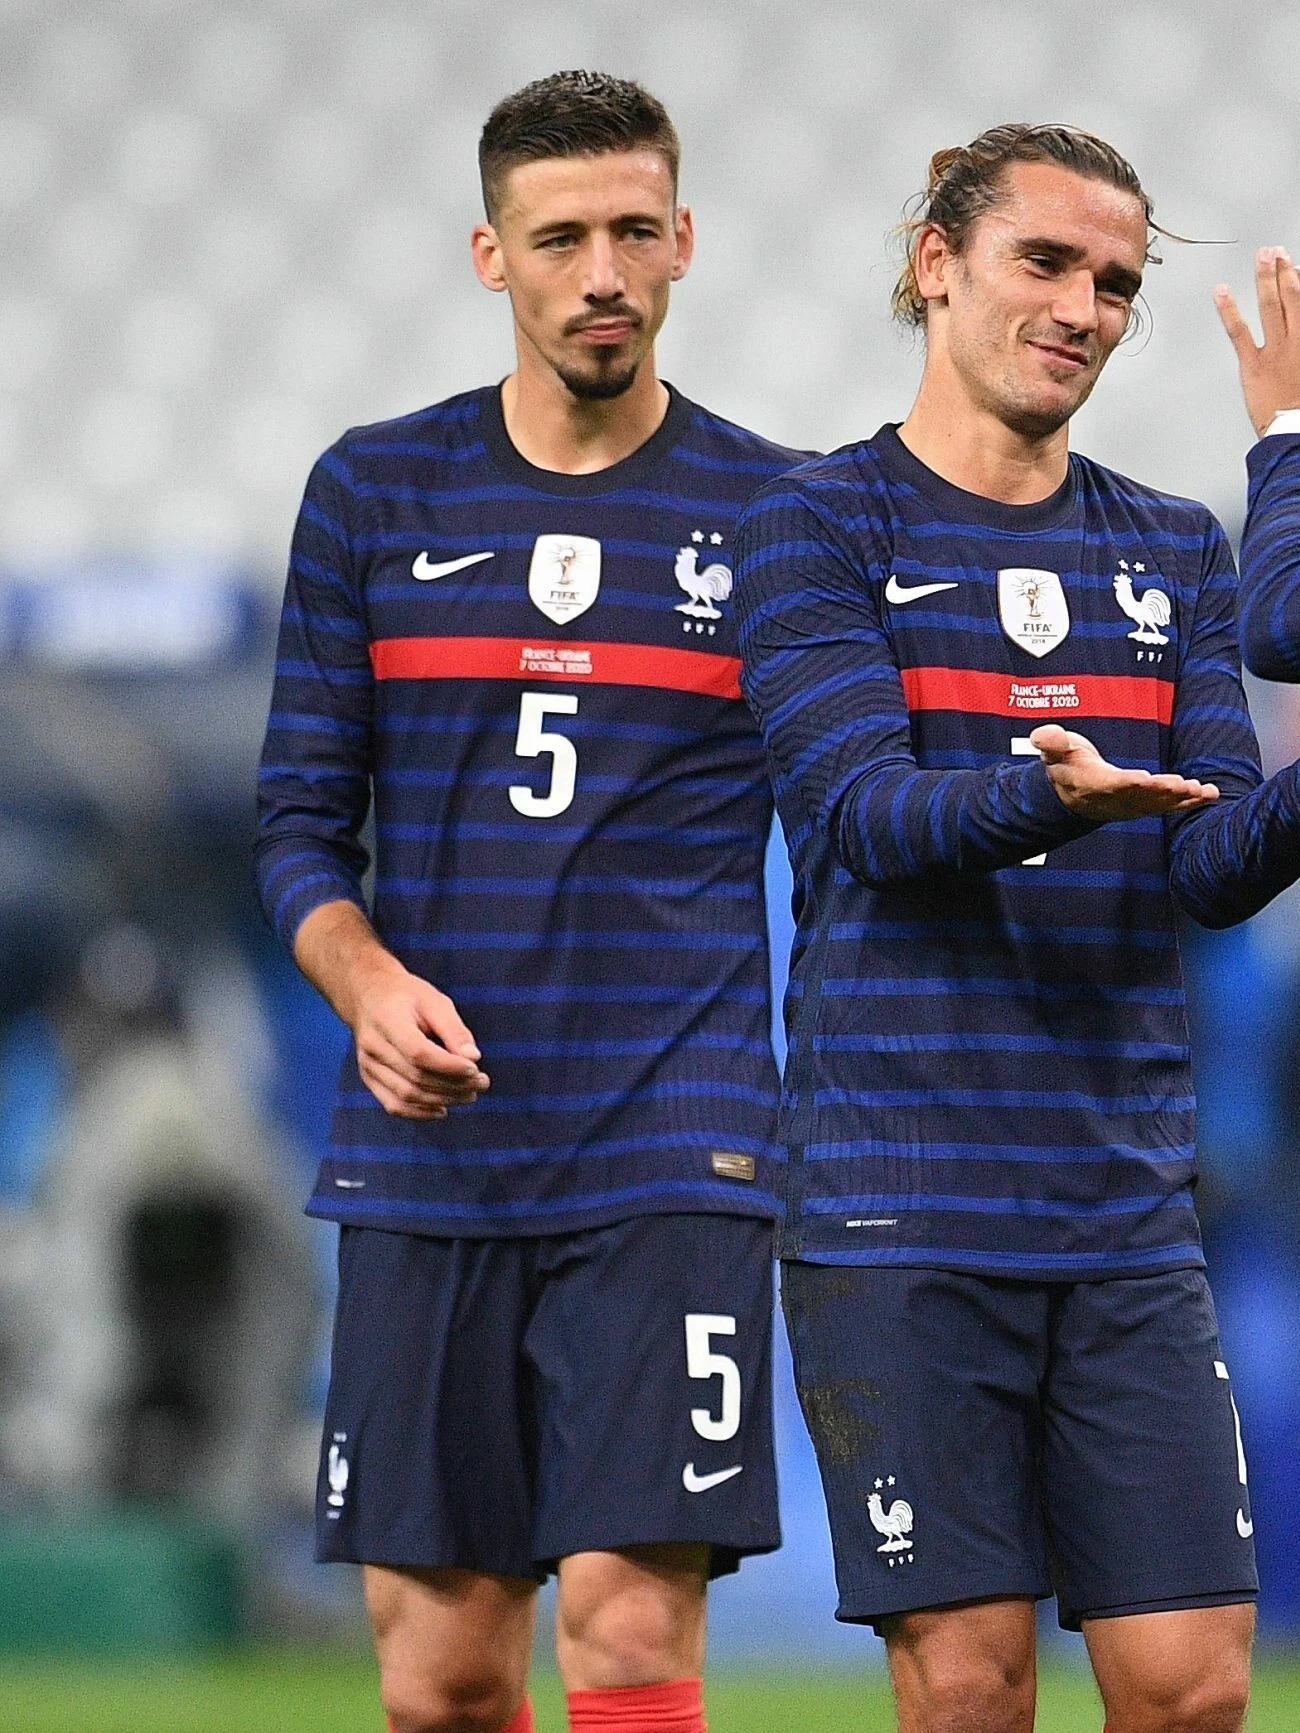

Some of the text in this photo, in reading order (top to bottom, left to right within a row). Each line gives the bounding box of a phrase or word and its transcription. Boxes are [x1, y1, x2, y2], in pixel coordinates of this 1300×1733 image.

[1023, 622, 1051, 633] FIFA
[1010, 683, 1077, 697] FRANCE-UKRAINE
[1007, 695, 1080, 709] 7 OCTOBRE 2020
[508, 692, 579, 818] 5
[684, 1314, 742, 1441] 5
